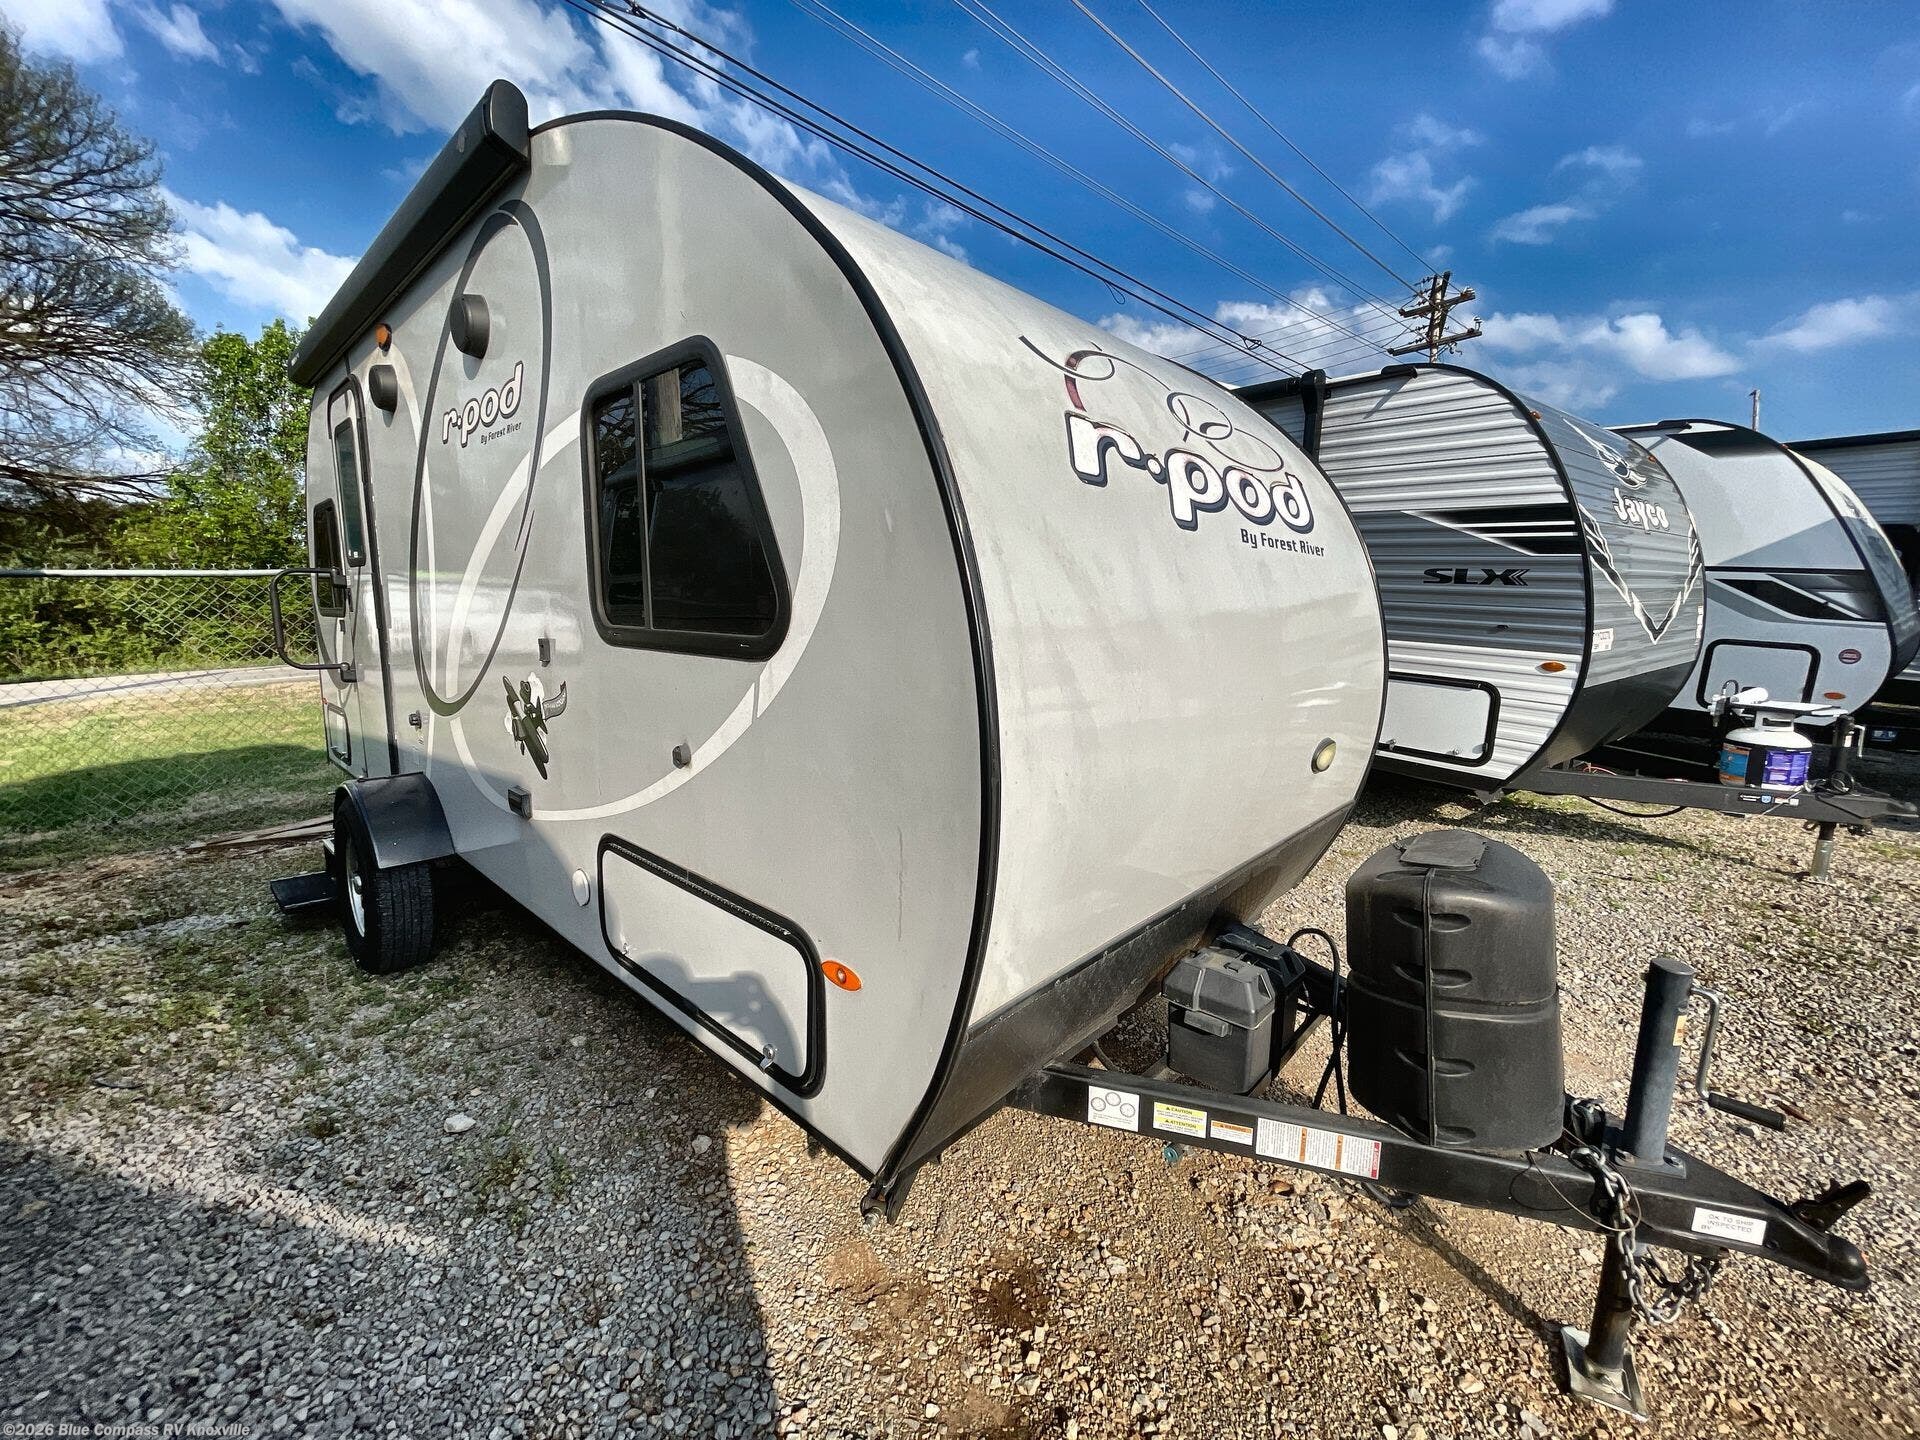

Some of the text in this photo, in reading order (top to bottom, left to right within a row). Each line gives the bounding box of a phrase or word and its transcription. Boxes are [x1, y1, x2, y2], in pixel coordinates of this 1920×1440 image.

[481, 422, 522, 445] By Forest River
[1612, 487, 1670, 535] Jayco
[1240, 528, 1325, 557] By Forest River
[1423, 568, 1530, 586] SLX
[1171, 1107, 1193, 1115] CAUTION
[1170, 1120, 1197, 1128] ATTENTION
[1707, 1220, 1752, 1232] INSPECTED
